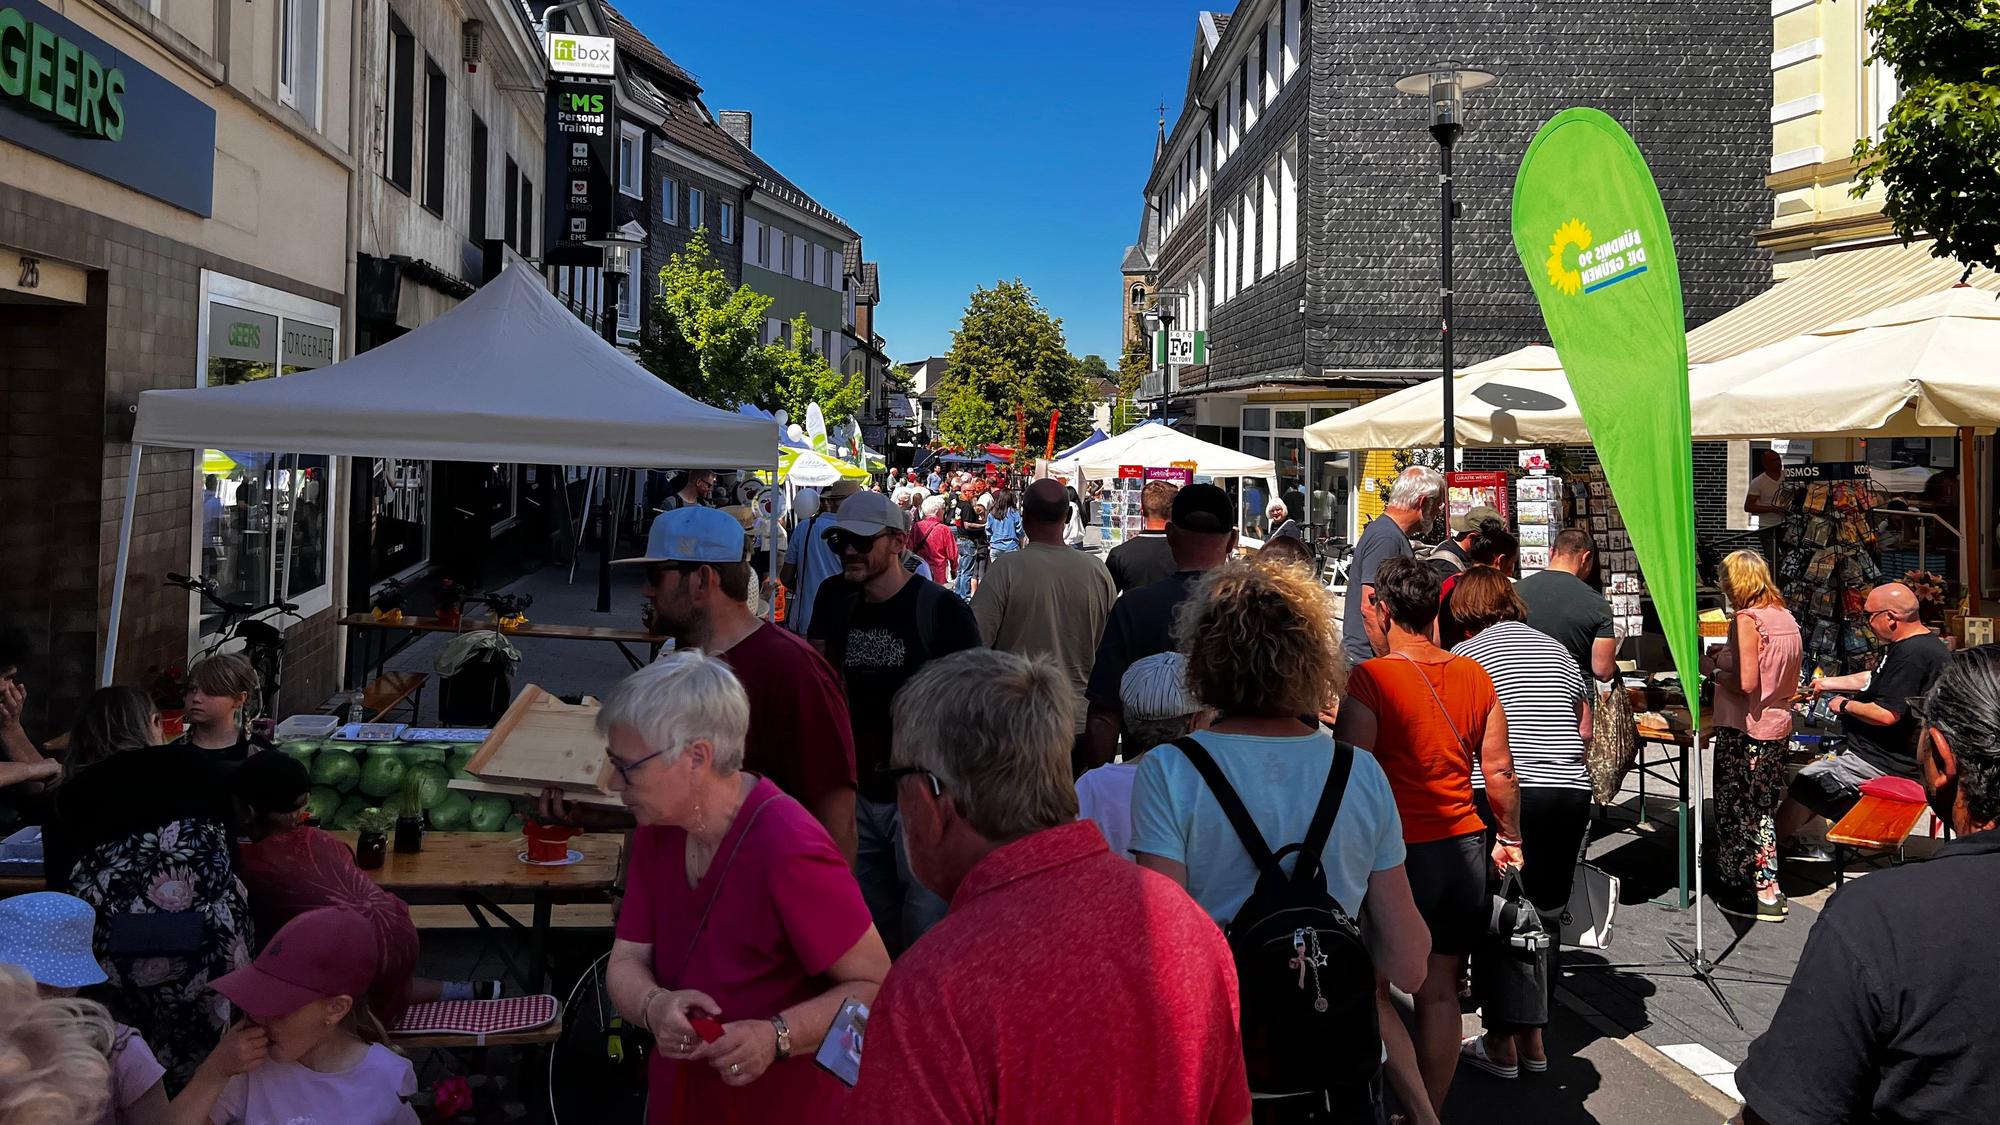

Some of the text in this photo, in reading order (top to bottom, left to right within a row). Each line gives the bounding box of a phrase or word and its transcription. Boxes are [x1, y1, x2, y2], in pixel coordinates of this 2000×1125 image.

[555, 40, 610, 61] fitbox
[0, 7, 126, 142] GEERS
[559, 93, 604, 113] EMS
[558, 112, 604, 123] Personal
[558, 122, 604, 136] Training
[572, 158, 588, 166] EMS
[571, 196, 588, 204] EMS
[570, 233, 587, 241] EMS
[18, 256, 40, 288] 25
[228, 322, 261, 350] GEERS
[1785, 466, 1820, 478] OSMOS
